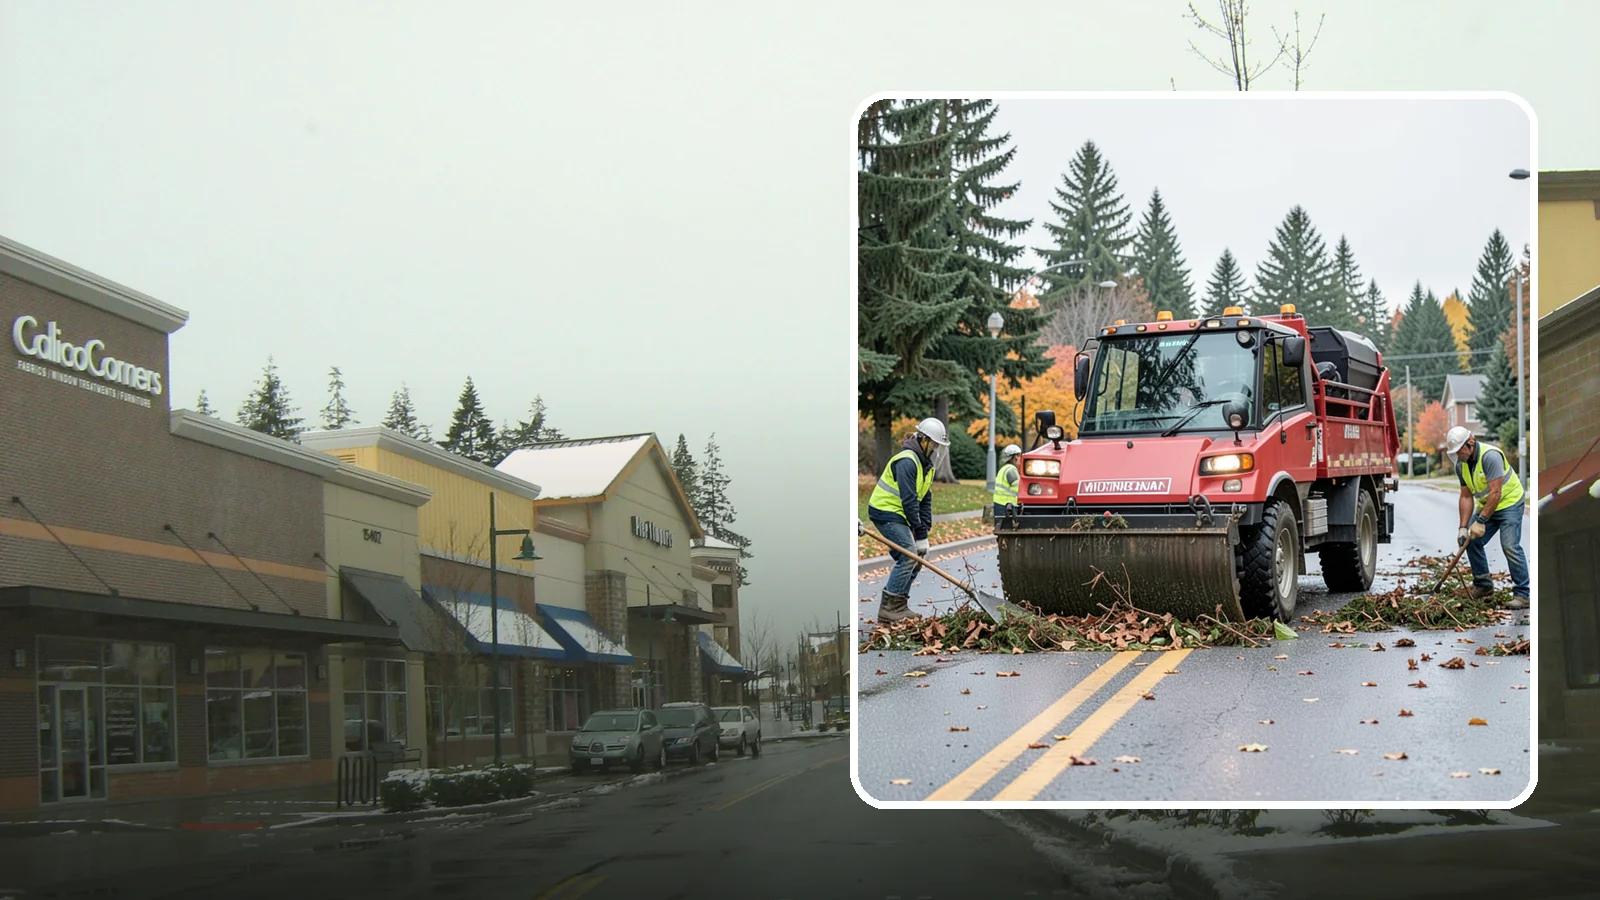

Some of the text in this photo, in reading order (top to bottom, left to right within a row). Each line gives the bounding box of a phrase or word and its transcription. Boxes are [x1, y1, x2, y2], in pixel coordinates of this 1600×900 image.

[17, 360, 47, 377] FABRICS
[51, 370, 78, 387] WINDOW
[79, 378, 117, 398] TREATMENTS
